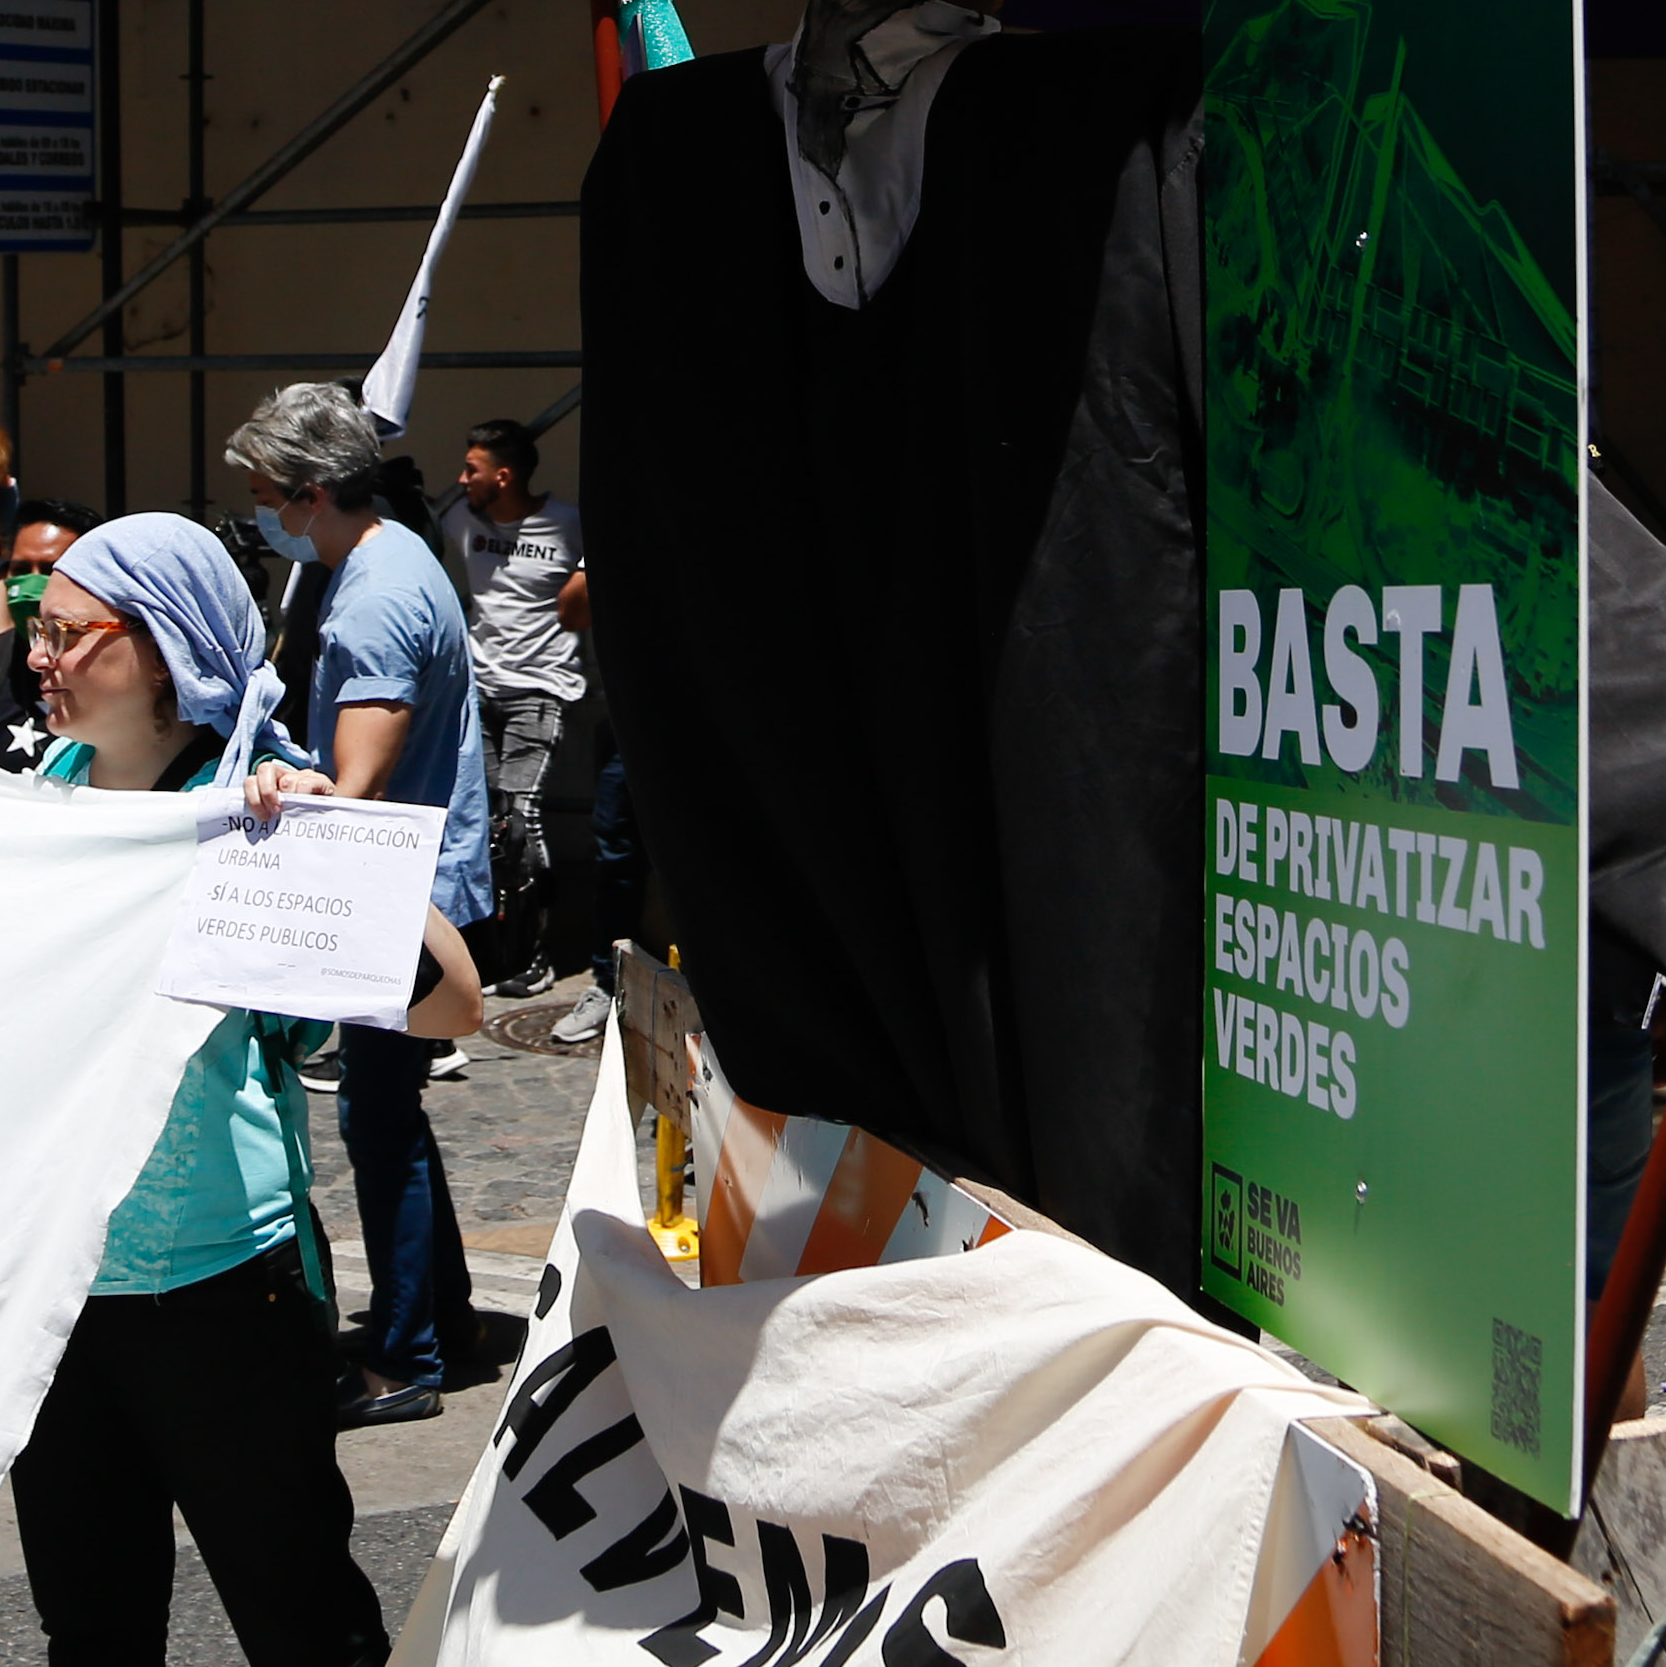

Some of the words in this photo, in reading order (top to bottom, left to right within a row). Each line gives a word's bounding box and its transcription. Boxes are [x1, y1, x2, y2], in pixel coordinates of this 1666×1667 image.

[1218, 583, 1520, 789] BASTA
[217, 848, 281, 870] URBANA
[259, 821, 270, 835] A
[295, 821, 420, 850] DENSIFICACIÓN
[1215, 797, 1259, 882] DE
[1266, 805, 1546, 950] PRIVATIZAR
[230, 889, 240, 904] A
[244, 889, 274, 909] LOS
[277, 892, 353, 918] ESPACIOS
[197, 917, 255, 941] VERDES
[259, 927, 339, 952] PUBLICOS
[1215, 892, 1411, 1028] ESPACIOS
[1213, 987, 1357, 1120] VERDES
[1247, 1181, 1272, 1229] SE
[1275, 1194, 1302, 1245] VA
[1247, 1225, 1301, 1280] BUENOS
[1246, 1261, 1285, 1307] AIRES
